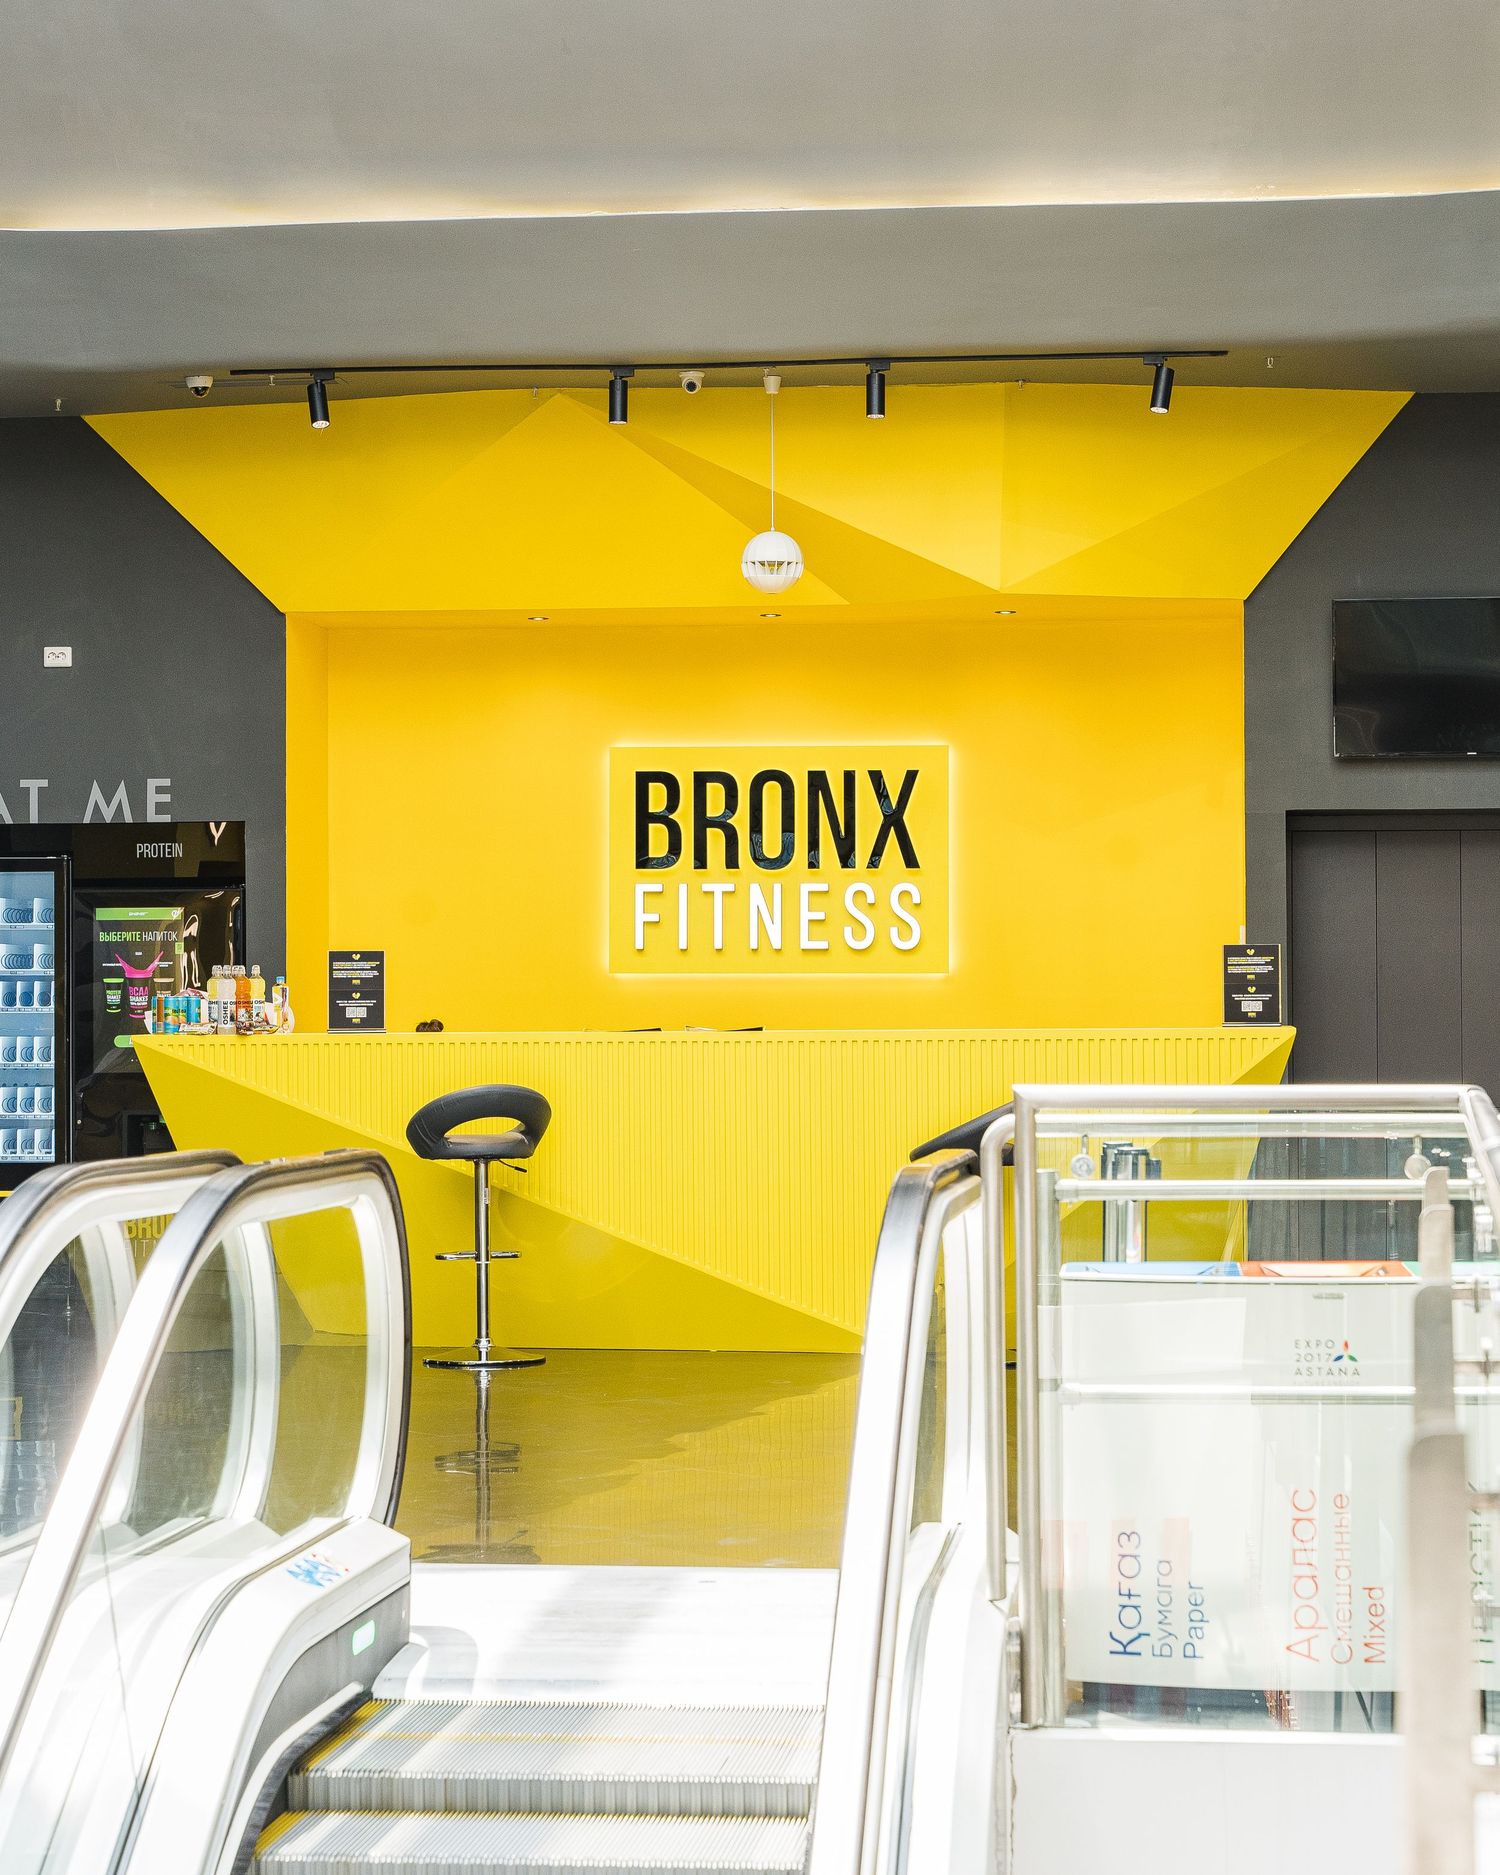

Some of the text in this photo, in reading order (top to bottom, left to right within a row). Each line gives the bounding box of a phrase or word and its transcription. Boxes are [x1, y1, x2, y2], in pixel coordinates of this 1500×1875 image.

[83, 778, 171, 824] ME
[635, 769, 921, 870] BRONX
[136, 842, 183, 858] PROTEIN
[99, 931, 178, 941] ВЫБЕРИТЕ НАПИТОК
[634, 882, 921, 951] FITNESS
[128, 986, 149, 996] BCAA
[1294, 1339, 1335, 1349] EXPO
[1294, 1366, 1360, 1376] ASTANA
[1295, 1352, 1332, 1362] 2017
[1109, 1531, 1150, 1657] Қағаз
[1152, 1559, 1178, 1658] Бумага
[1286, 1489, 1328, 1662] Аралас
[1331, 1493, 1353, 1665] Смешанные
[1183, 1581, 1210, 1659] Paper
[1362, 1586, 1386, 1664] Mixed
